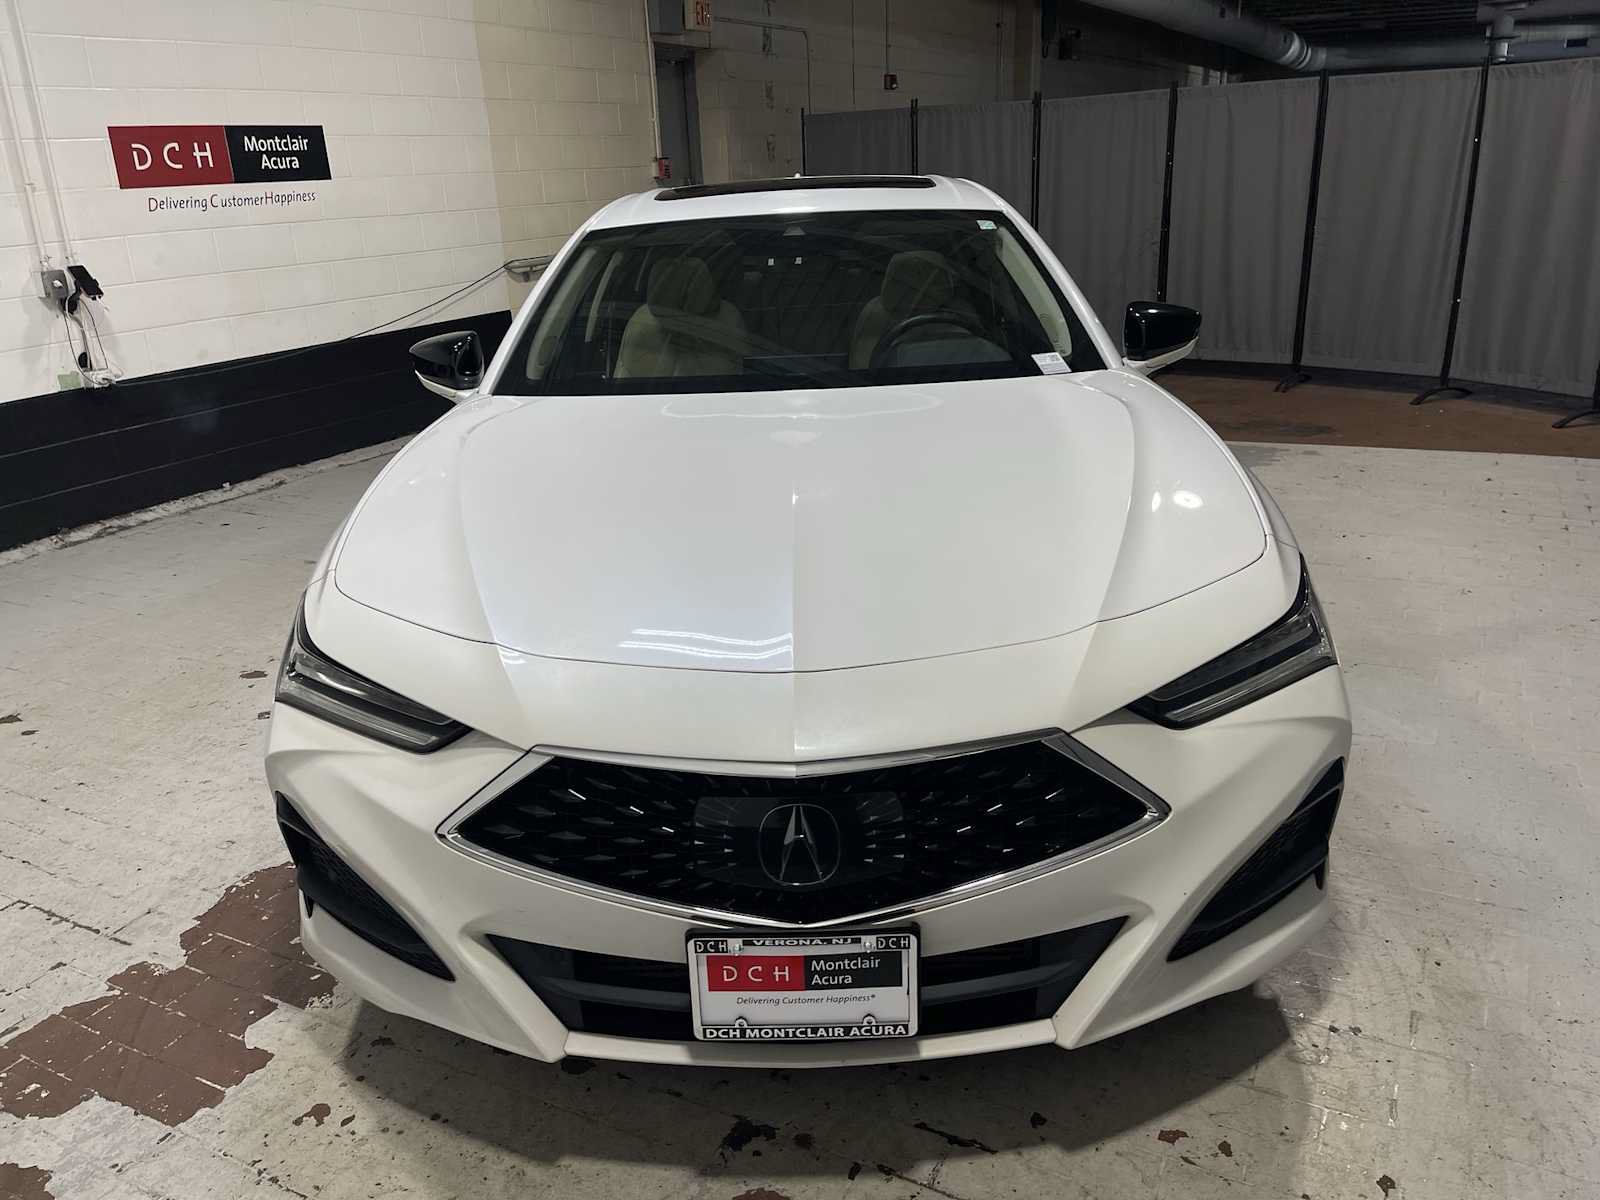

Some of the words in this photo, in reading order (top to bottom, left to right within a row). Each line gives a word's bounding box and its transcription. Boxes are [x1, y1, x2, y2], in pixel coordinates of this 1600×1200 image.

[243, 135, 309, 152] Montclair
[261, 154, 300, 170] Acura
[148, 196, 208, 212] Delivering
[695, 940, 728, 953] DCH
[877, 936, 910, 949] DCH
[811, 956, 881, 972] Montclair
[811, 973, 852, 986] Acura
[736, 995, 780, 1006] Delivering
[782, 995, 824, 1005] Customer
[705, 1027, 741, 1039] DCH
[745, 1027, 845, 1038] MONTCLAIR
[849, 1025, 906, 1037] ACURA
